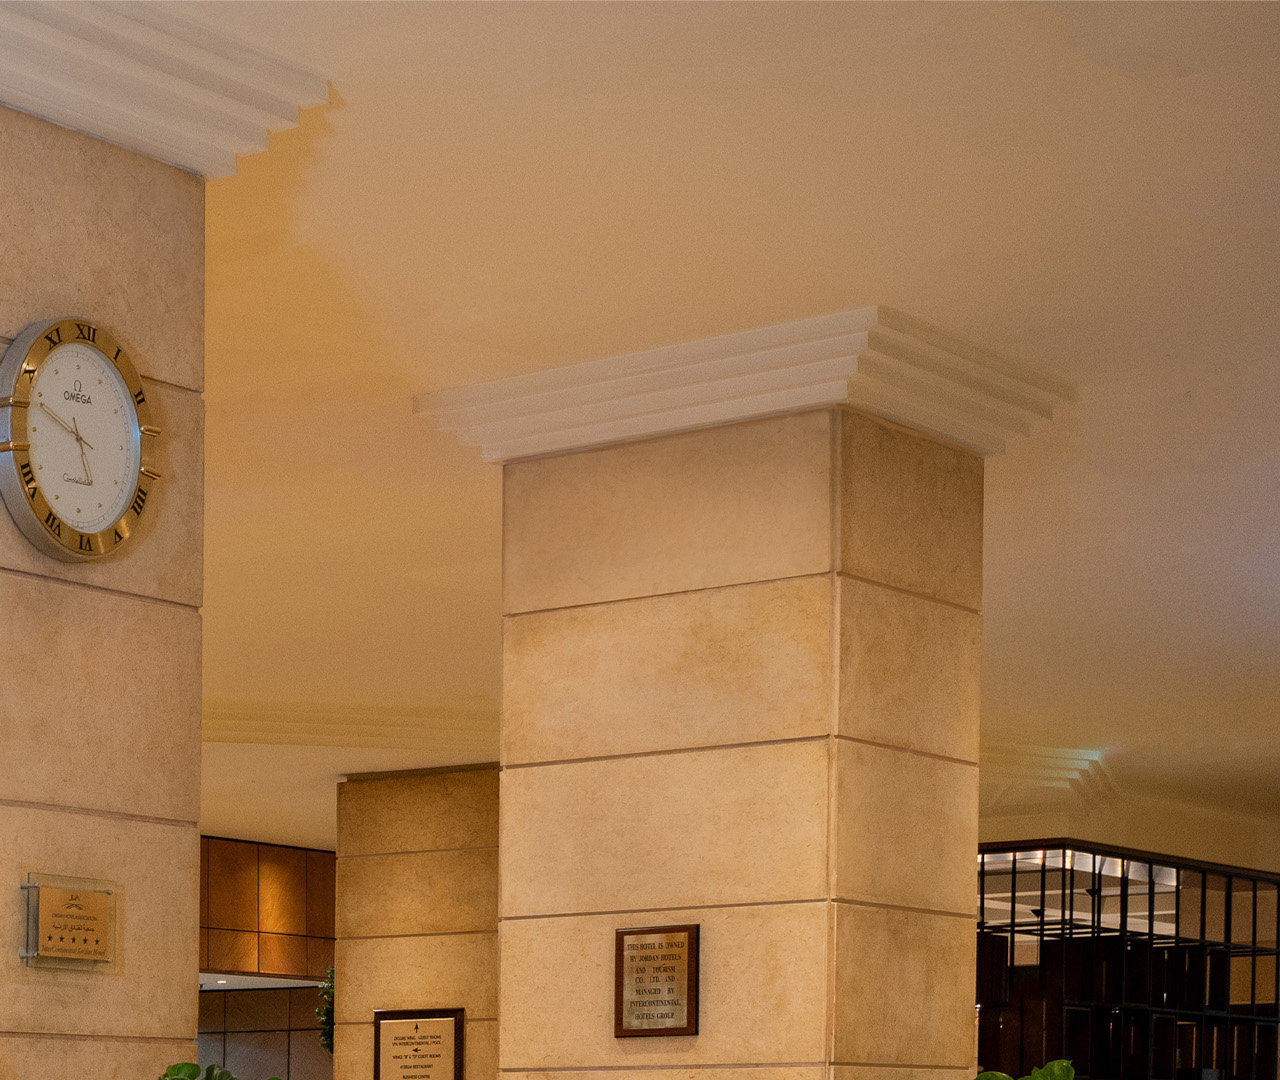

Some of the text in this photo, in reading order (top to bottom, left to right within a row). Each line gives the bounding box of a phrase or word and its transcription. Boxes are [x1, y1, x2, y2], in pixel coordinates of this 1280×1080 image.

[75, 323, 97, 344] XII
[44, 327, 61, 351] XI
[63, 390, 93, 406] OMEGA
[666, 941, 685, 949] OWNED
[640, 954, 659, 962] JORDAN
[661, 953, 682, 961] HOTELS
[636, 966, 646, 974] AND
[635, 1012, 655, 1020] HOTELS
